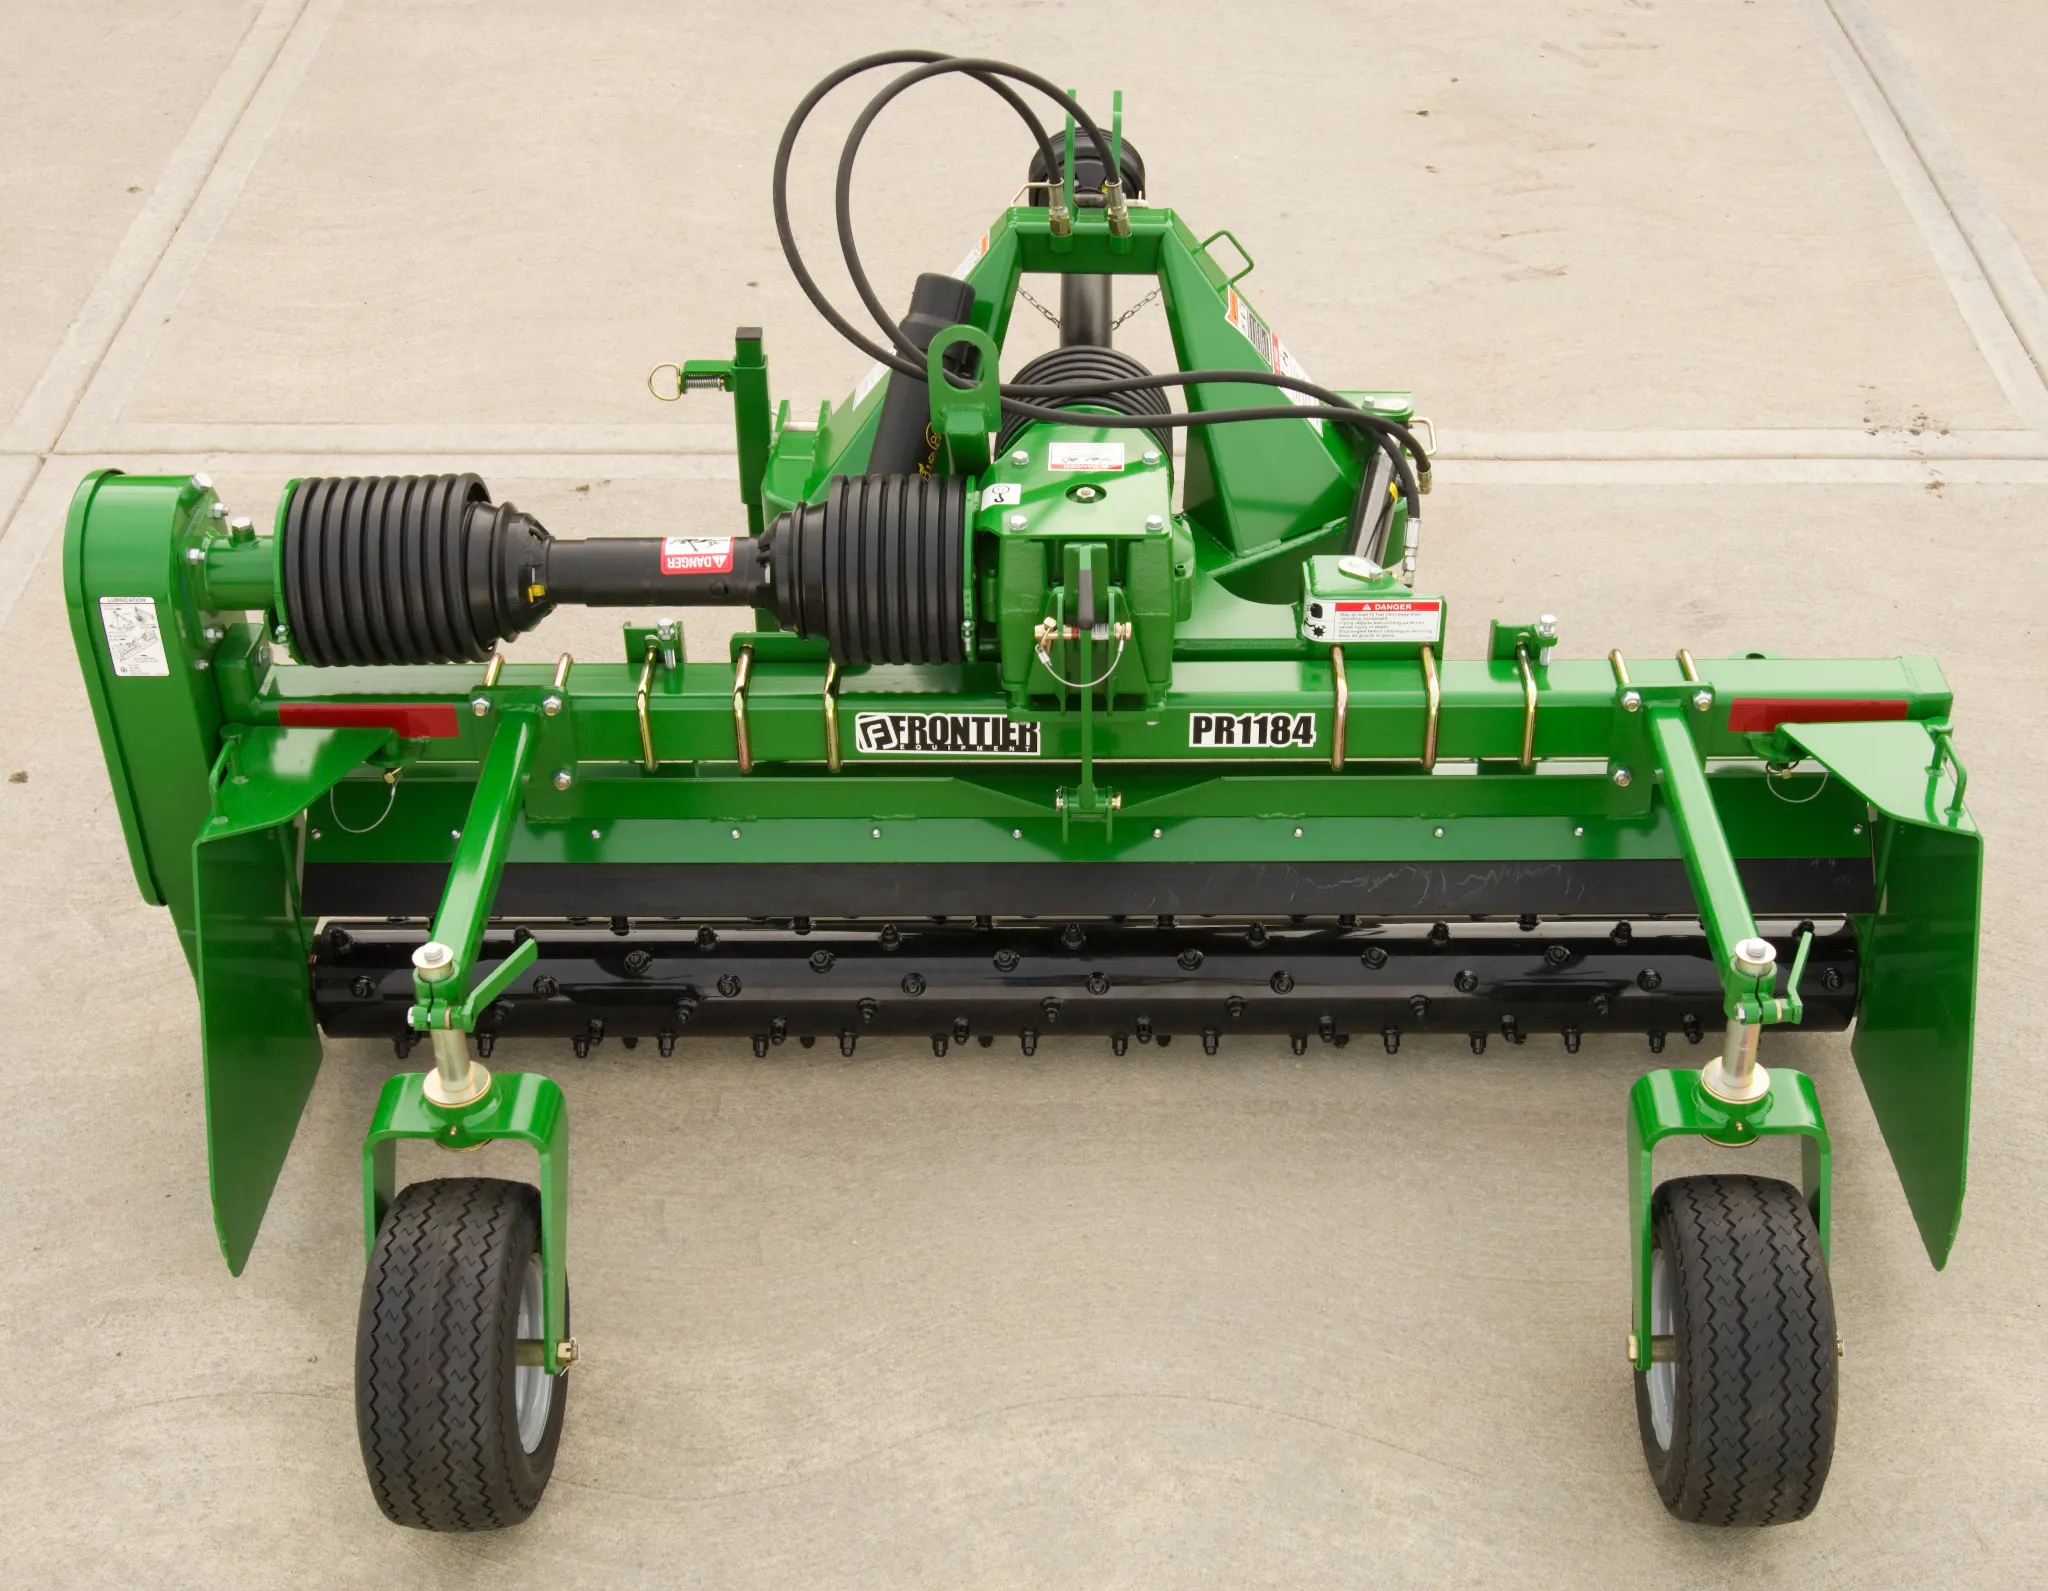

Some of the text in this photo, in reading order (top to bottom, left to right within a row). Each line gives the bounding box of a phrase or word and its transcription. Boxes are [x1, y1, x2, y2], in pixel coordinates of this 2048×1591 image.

[667, 556, 712, 569] DANGER
[1374, 603, 1412, 611] DANGER
[891, 714, 1038, 746] FRONTIER
[1192, 715, 1314, 745] PR1184
[899, 744, 1031, 752] EQUIPMENT
